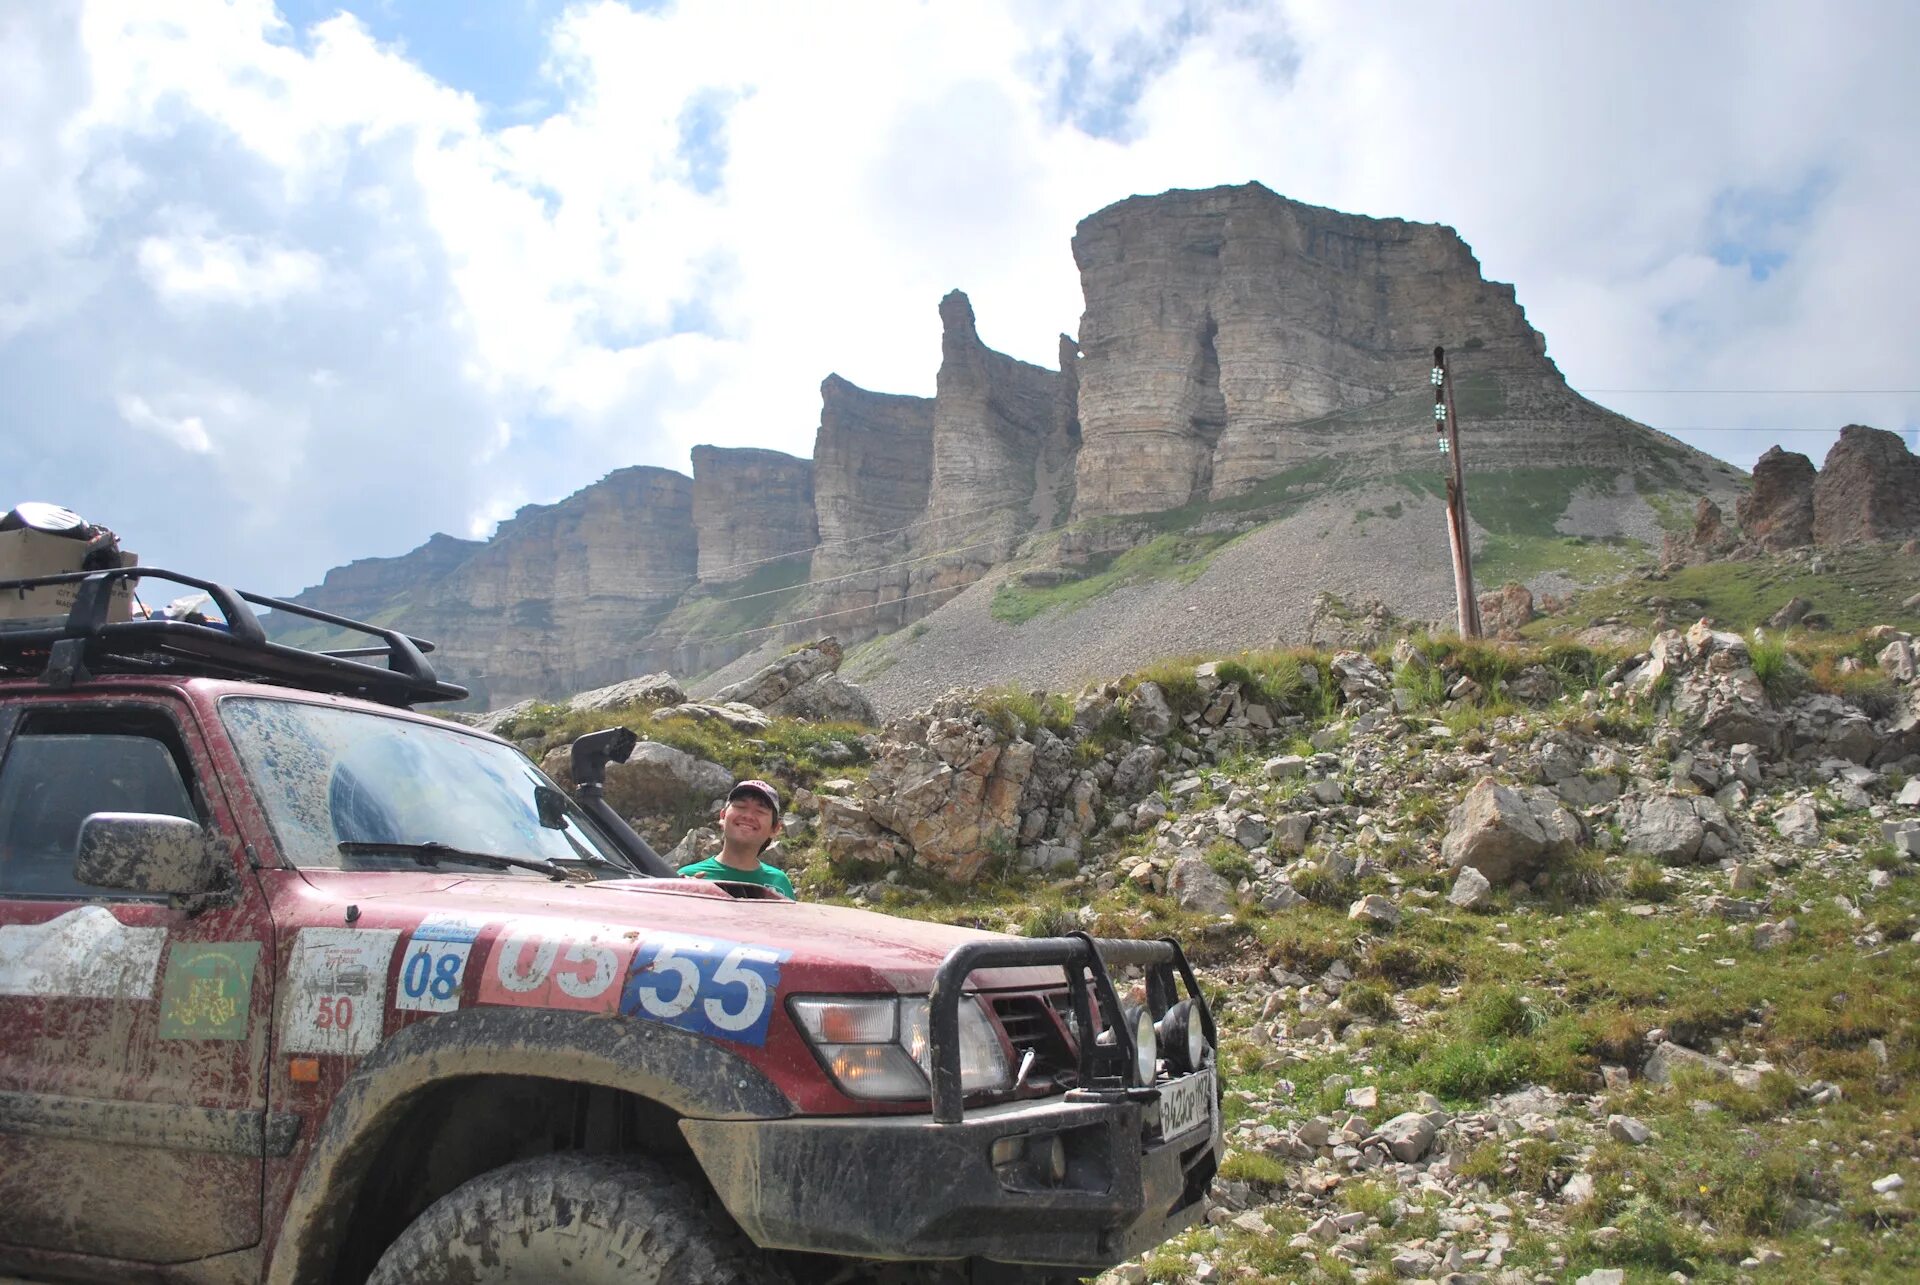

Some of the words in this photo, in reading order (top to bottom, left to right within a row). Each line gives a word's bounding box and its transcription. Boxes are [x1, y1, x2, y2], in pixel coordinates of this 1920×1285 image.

[404, 951, 461, 1000] 08
[497, 926, 619, 999] 05
[639, 936, 779, 1031] 55
[317, 995, 353, 1030] 50
